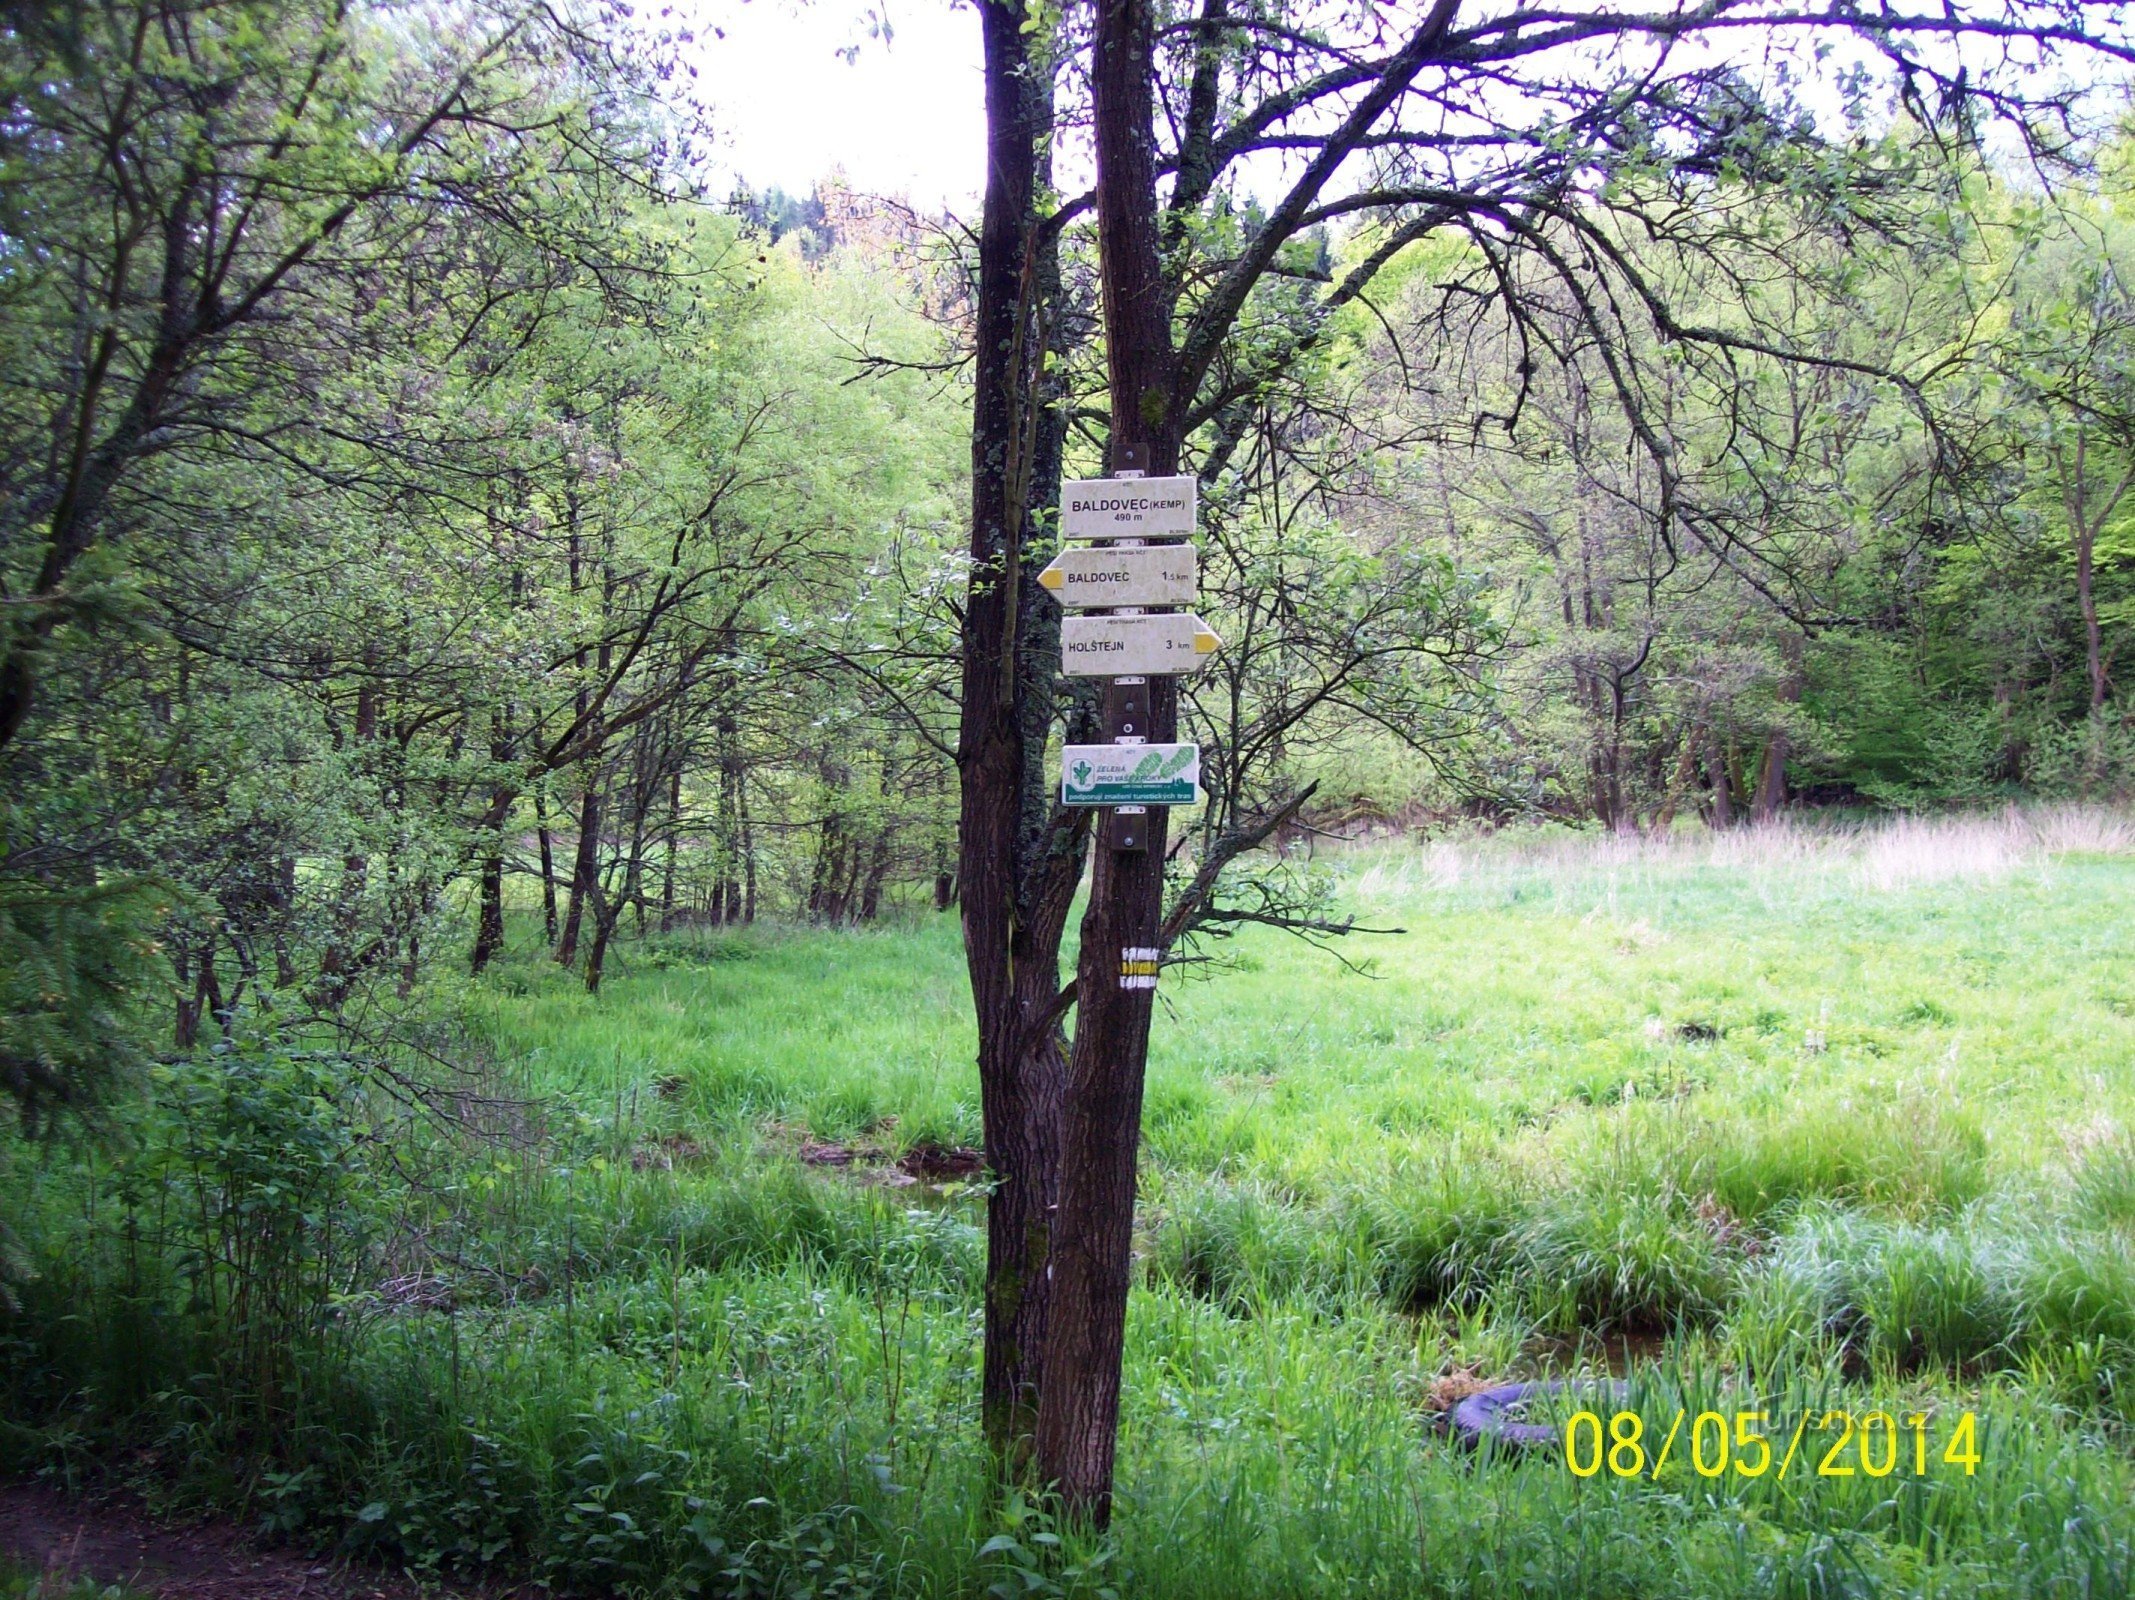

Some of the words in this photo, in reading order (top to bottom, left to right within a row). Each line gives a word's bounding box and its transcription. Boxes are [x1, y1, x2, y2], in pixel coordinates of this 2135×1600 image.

[1114, 513, 1131, 521] 490
[1068, 572, 1129, 583] BALDOVEC
[1068, 640, 1124, 652] HOLŠTEJN
[1165, 640, 1173, 649] 3
